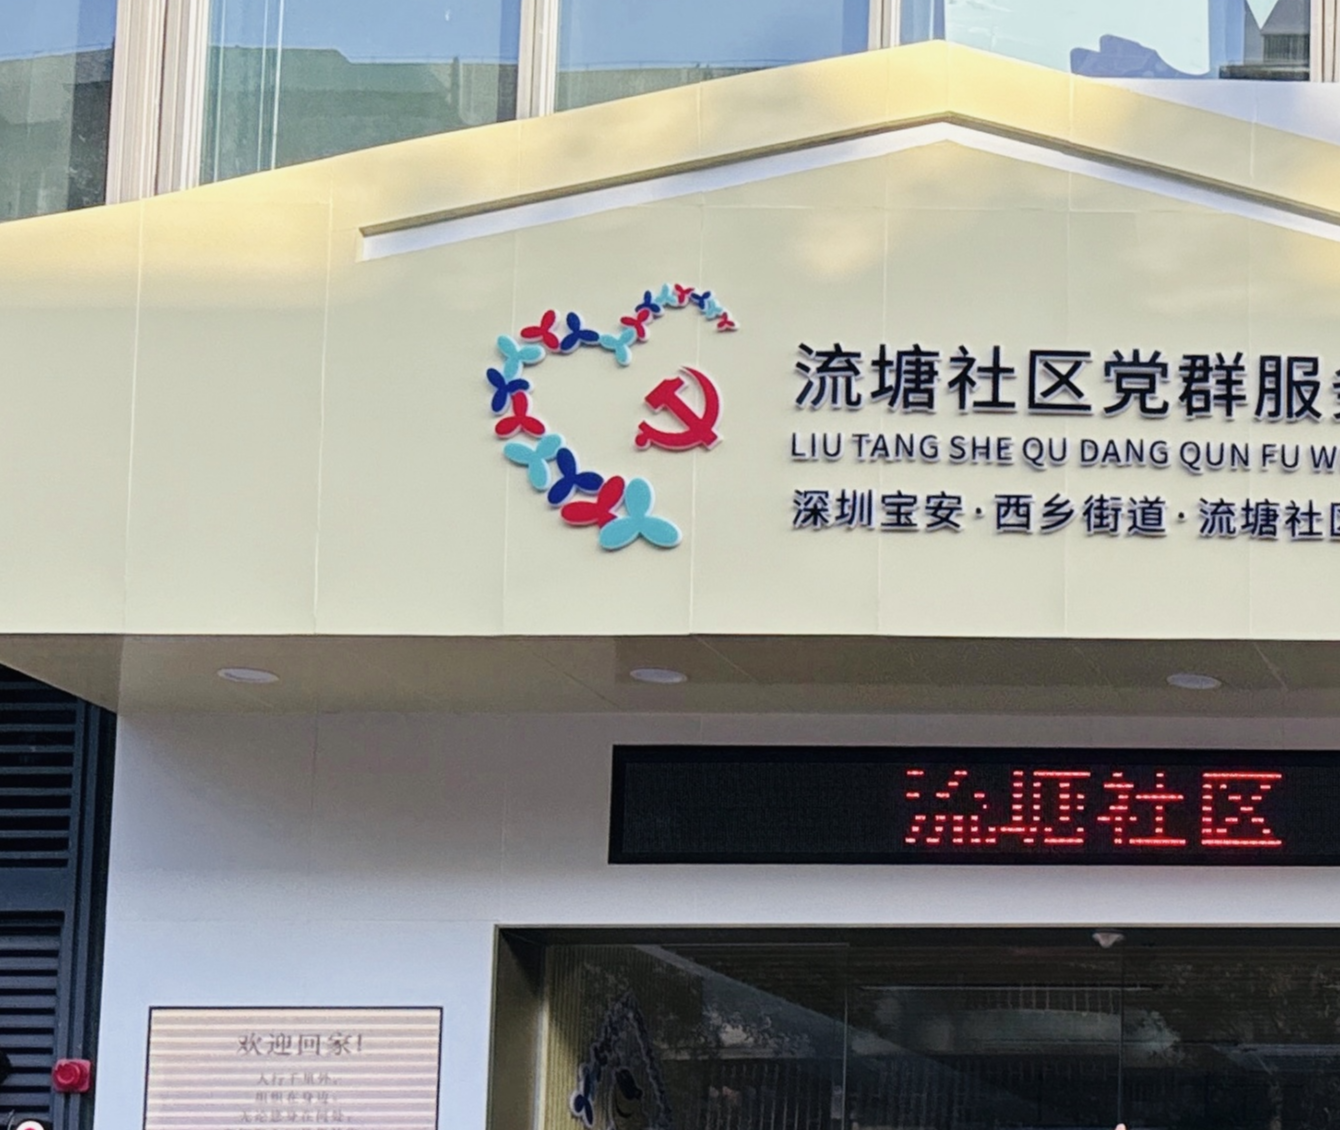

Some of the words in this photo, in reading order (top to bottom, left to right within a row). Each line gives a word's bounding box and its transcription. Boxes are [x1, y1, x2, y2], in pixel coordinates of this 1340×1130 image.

[791, 432, 843, 461] LIU
[852, 433, 940, 462] TANG
[949, 436, 1014, 464] SHE
[1021, 437, 1068, 468] QU
[1080, 438, 1170, 467] DANG
[1179, 440, 1250, 474] QUN
[1261, 443, 1301, 471] FU
